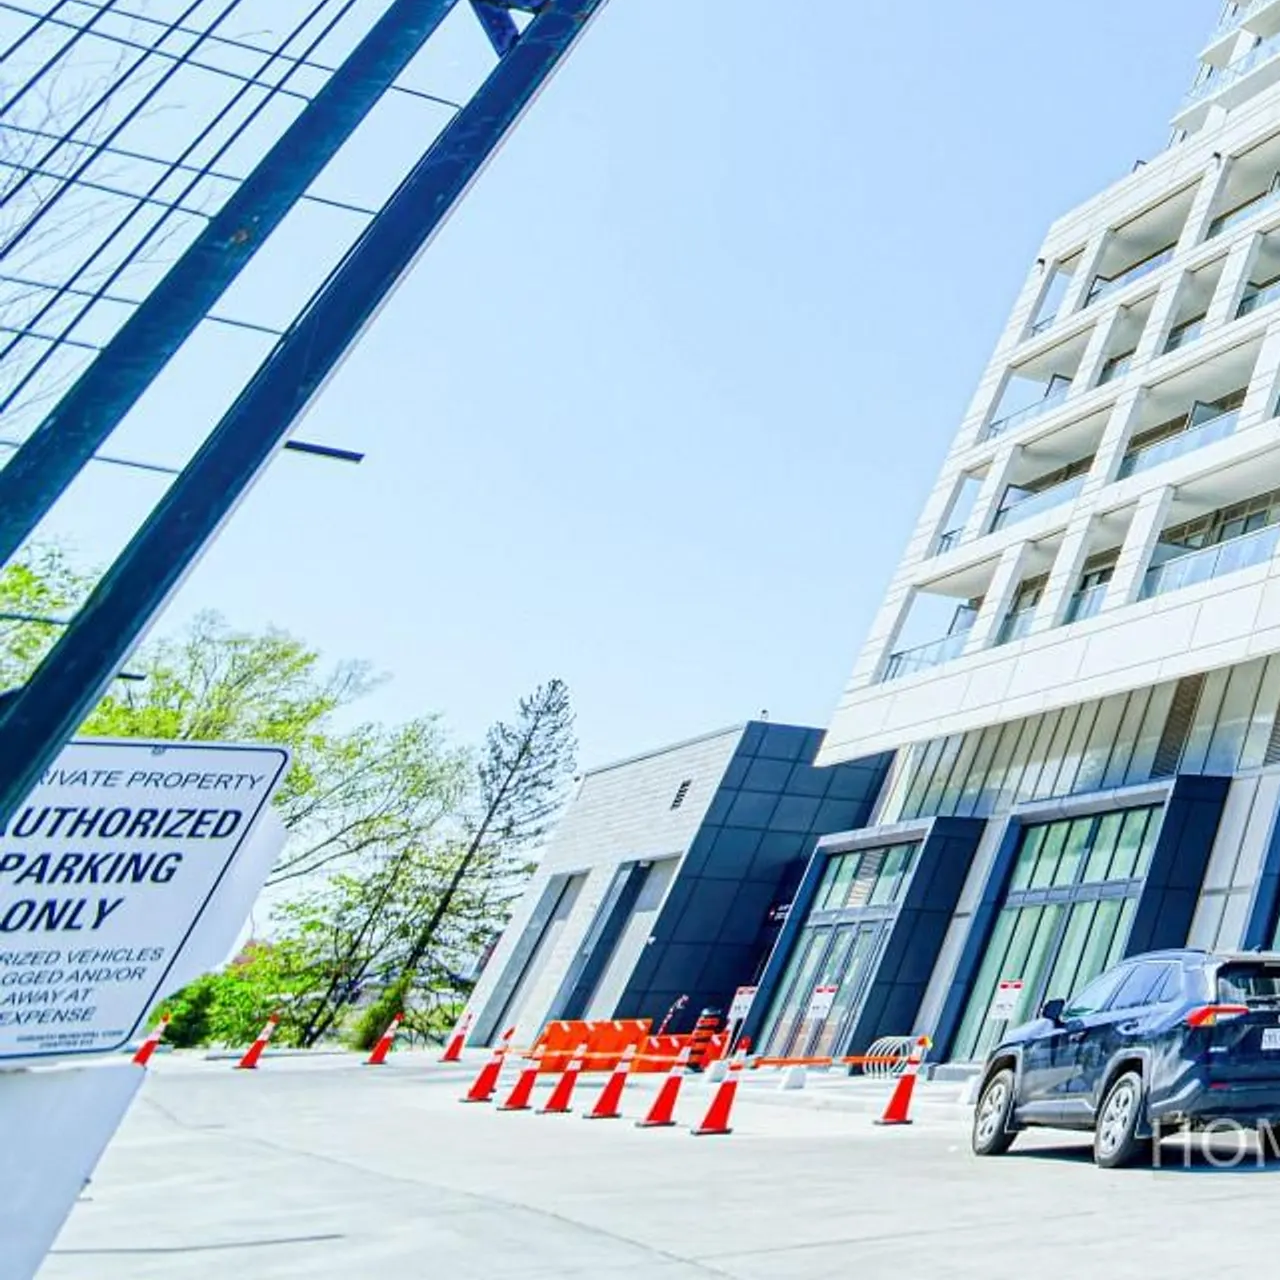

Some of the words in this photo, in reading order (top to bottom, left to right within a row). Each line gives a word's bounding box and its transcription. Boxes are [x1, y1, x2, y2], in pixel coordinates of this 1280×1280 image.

[126, 770, 265, 791] PROPERTY
[0, 806, 243, 839] UTHORIZED
[0, 852, 183, 885] PARKING
[0, 898, 124, 932] ONLY
[67, 947, 164, 965] VEHICLES
[65, 966, 147, 984] AND/OR
[1, 990, 63, 1006] AWAY
[64, 987, 93, 1003] AT
[0, 1006, 97, 1026] EXPENSE
